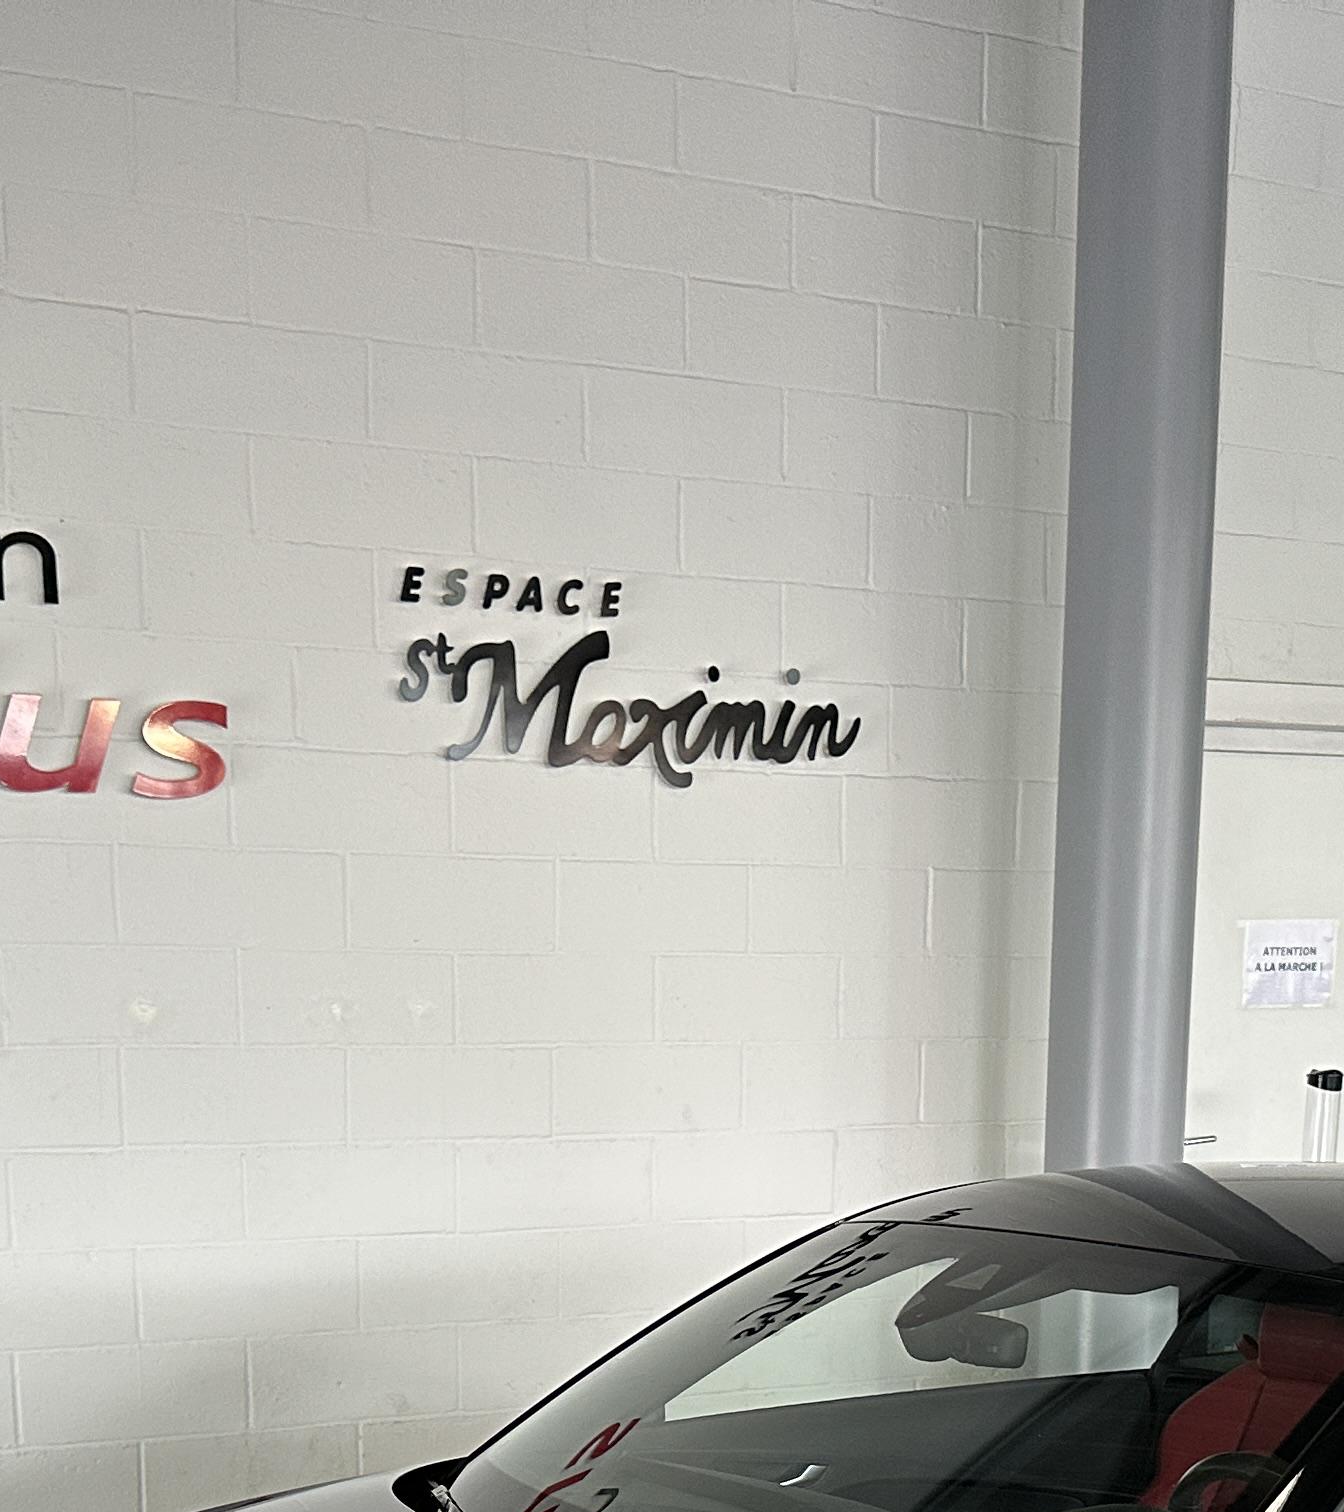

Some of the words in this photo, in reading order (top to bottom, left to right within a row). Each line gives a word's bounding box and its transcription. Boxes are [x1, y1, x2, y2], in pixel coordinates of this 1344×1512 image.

[400, 566, 622, 618] ESPACE
[446, 630, 861, 788] Maximin
[1262, 946, 1317, 957] ATTENTION
[1264, 962, 1276, 972] LA
[1278, 962, 1318, 972] MARCHE
